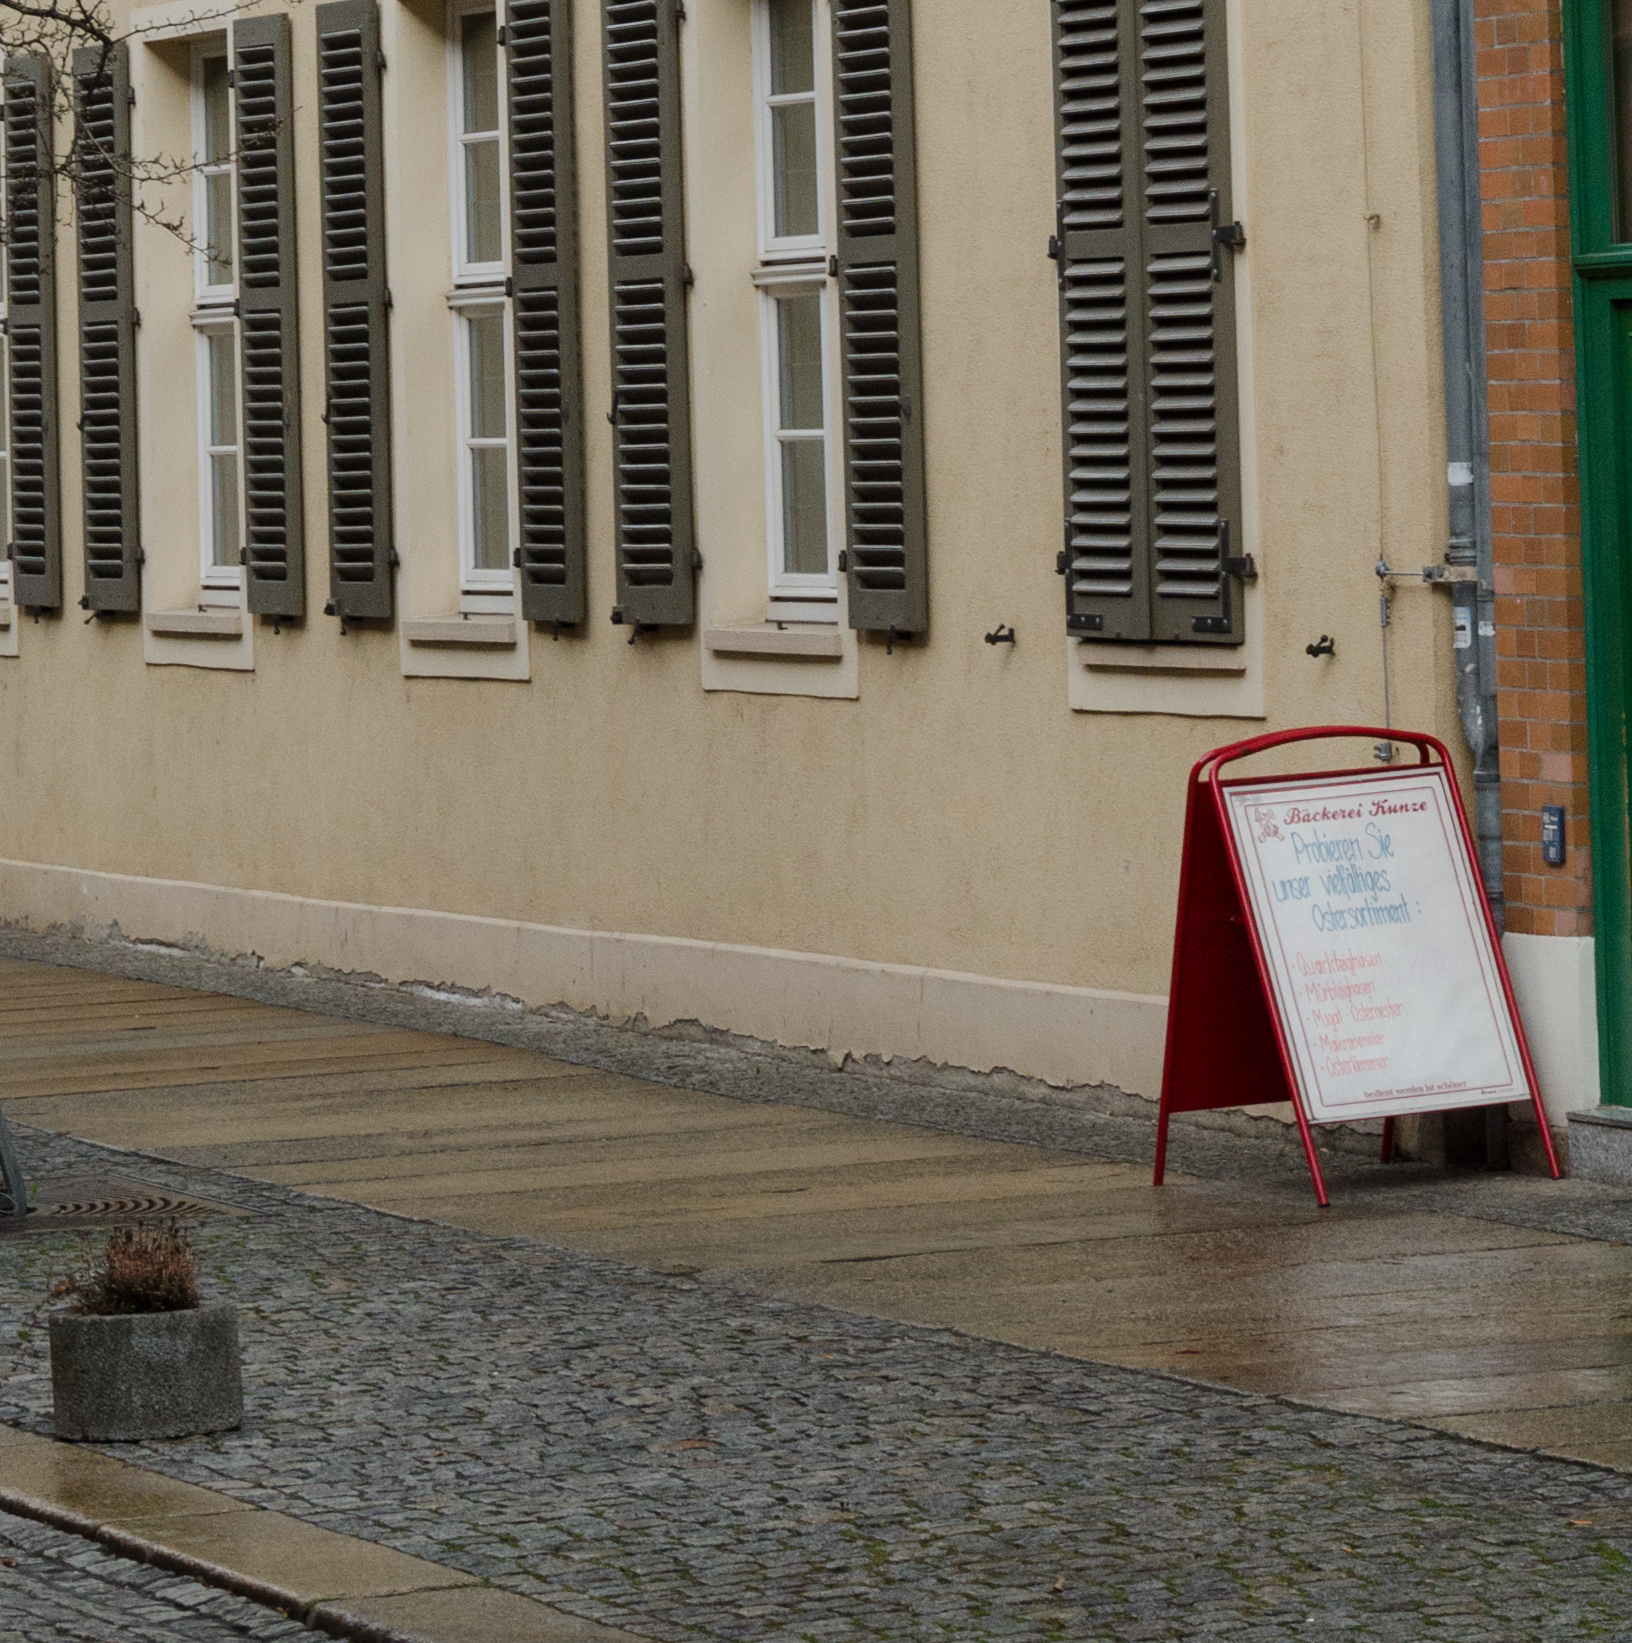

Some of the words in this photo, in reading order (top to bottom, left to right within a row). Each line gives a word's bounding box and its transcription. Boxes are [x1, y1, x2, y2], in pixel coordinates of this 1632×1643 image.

[1283, 803, 1363, 825] Bäckerei
[1369, 799, 1427, 816] Kunze
[1290, 828, 1364, 864] Probieren
[1365, 822, 1394, 859] Sie
[1271, 876, 1311, 902] unser
[1319, 863, 1391, 902] vielfältiges
